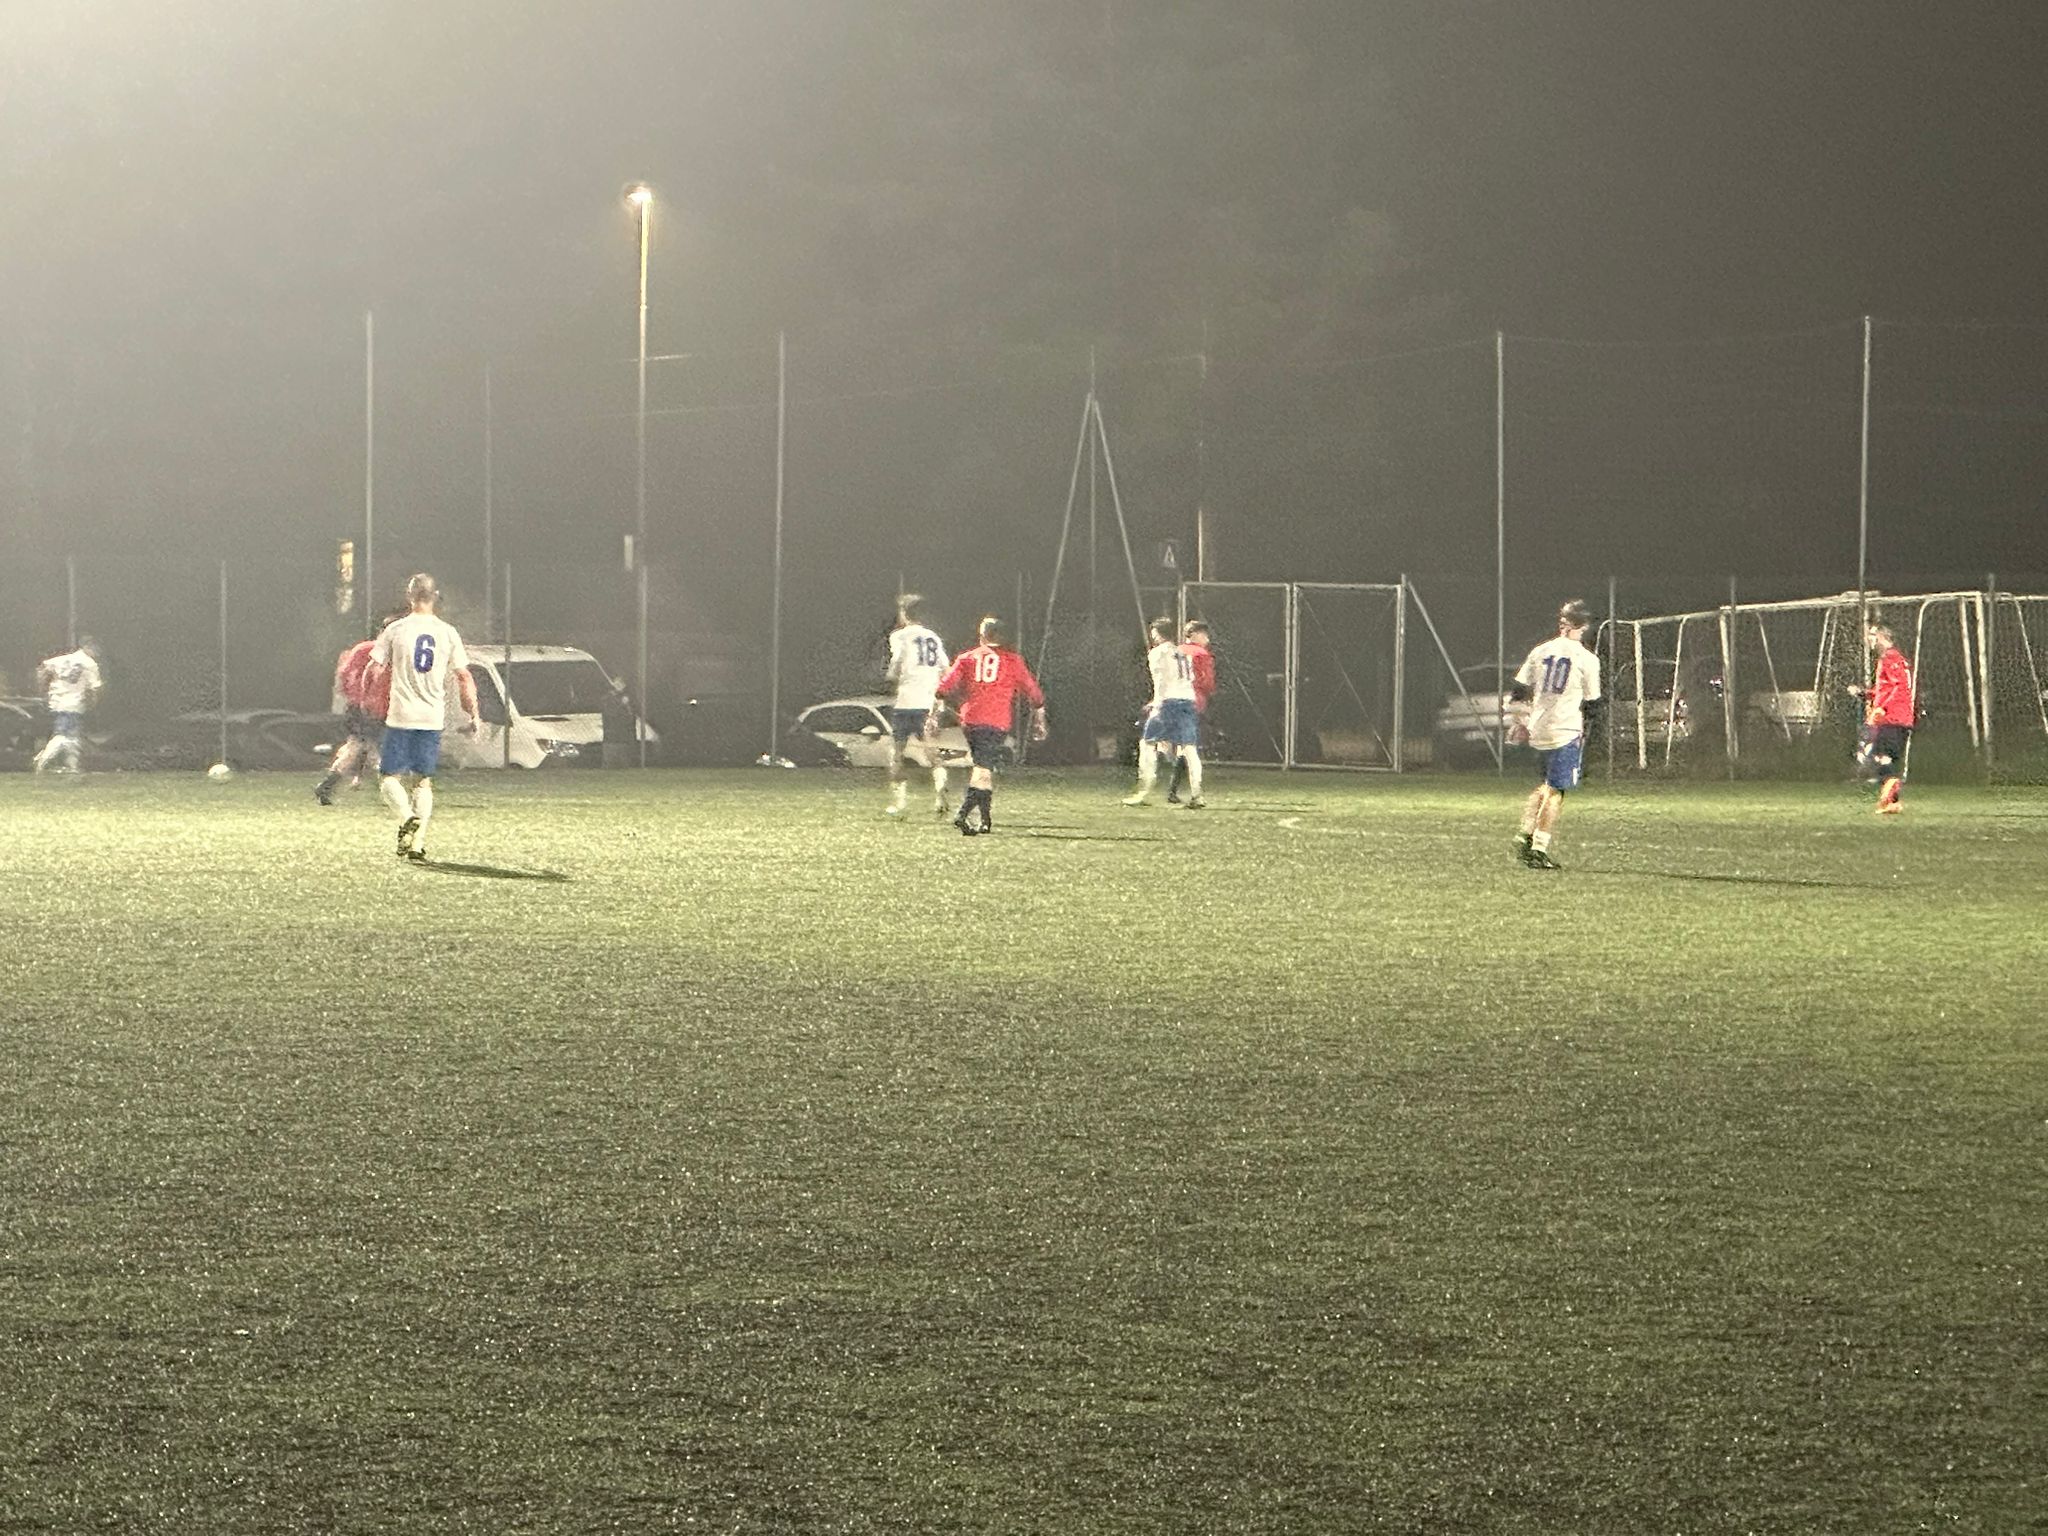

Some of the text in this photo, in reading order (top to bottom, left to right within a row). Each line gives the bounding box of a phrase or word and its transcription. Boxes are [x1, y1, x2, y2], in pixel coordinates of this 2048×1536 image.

[414, 633, 436, 674] 6
[913, 636, 938, 667] 18
[1173, 652, 1191, 681] 11
[974, 653, 999, 683] 18
[1542, 655, 1572, 694] 10
